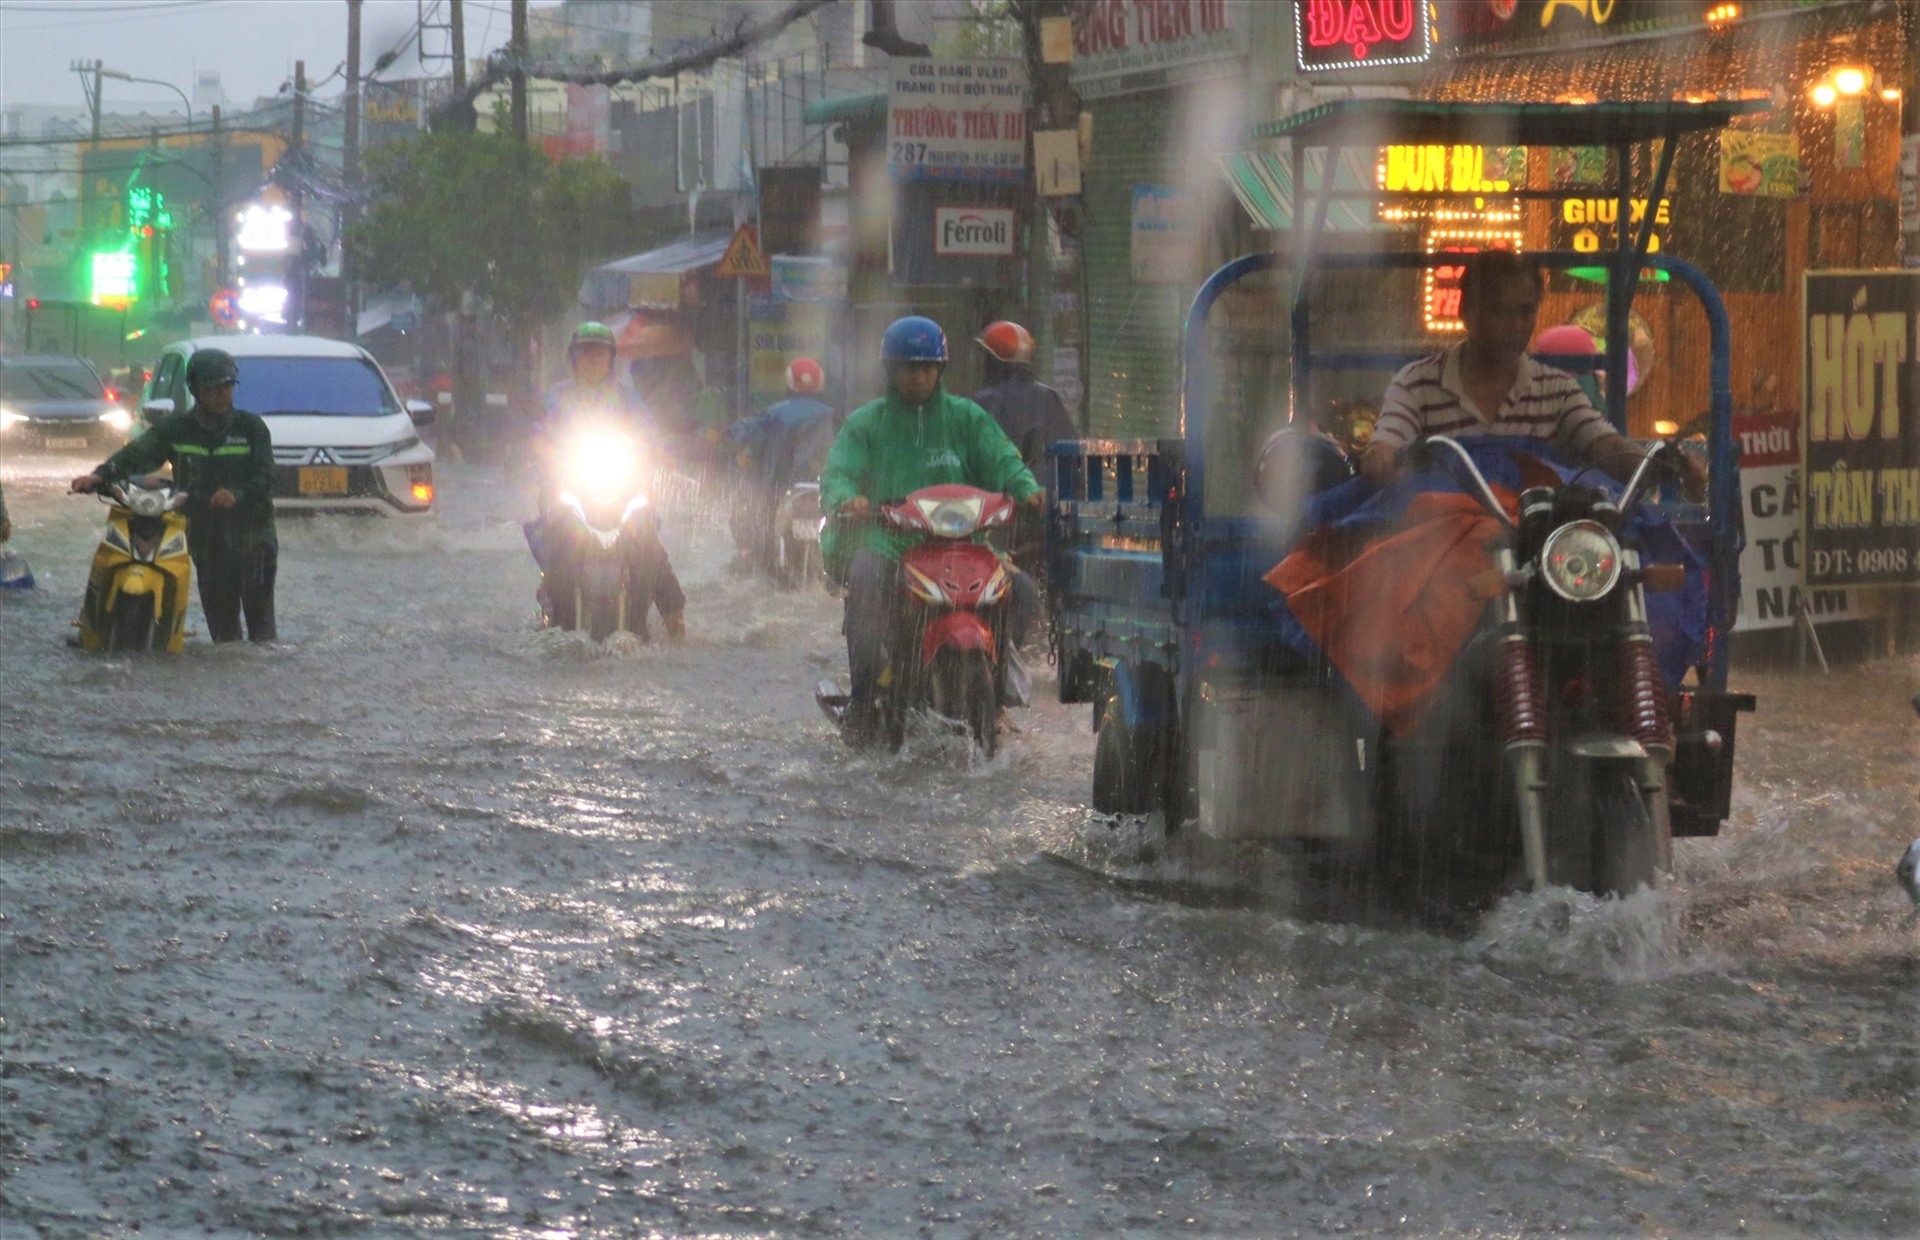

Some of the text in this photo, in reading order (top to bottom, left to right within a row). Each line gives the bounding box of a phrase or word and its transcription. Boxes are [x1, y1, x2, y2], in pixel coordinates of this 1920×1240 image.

[893, 142, 927, 163] 287
[943, 220, 1006, 248] Ferroli
[1810, 458, 1874, 529] TÂN
[1857, 548, 1907, 574] 0908
